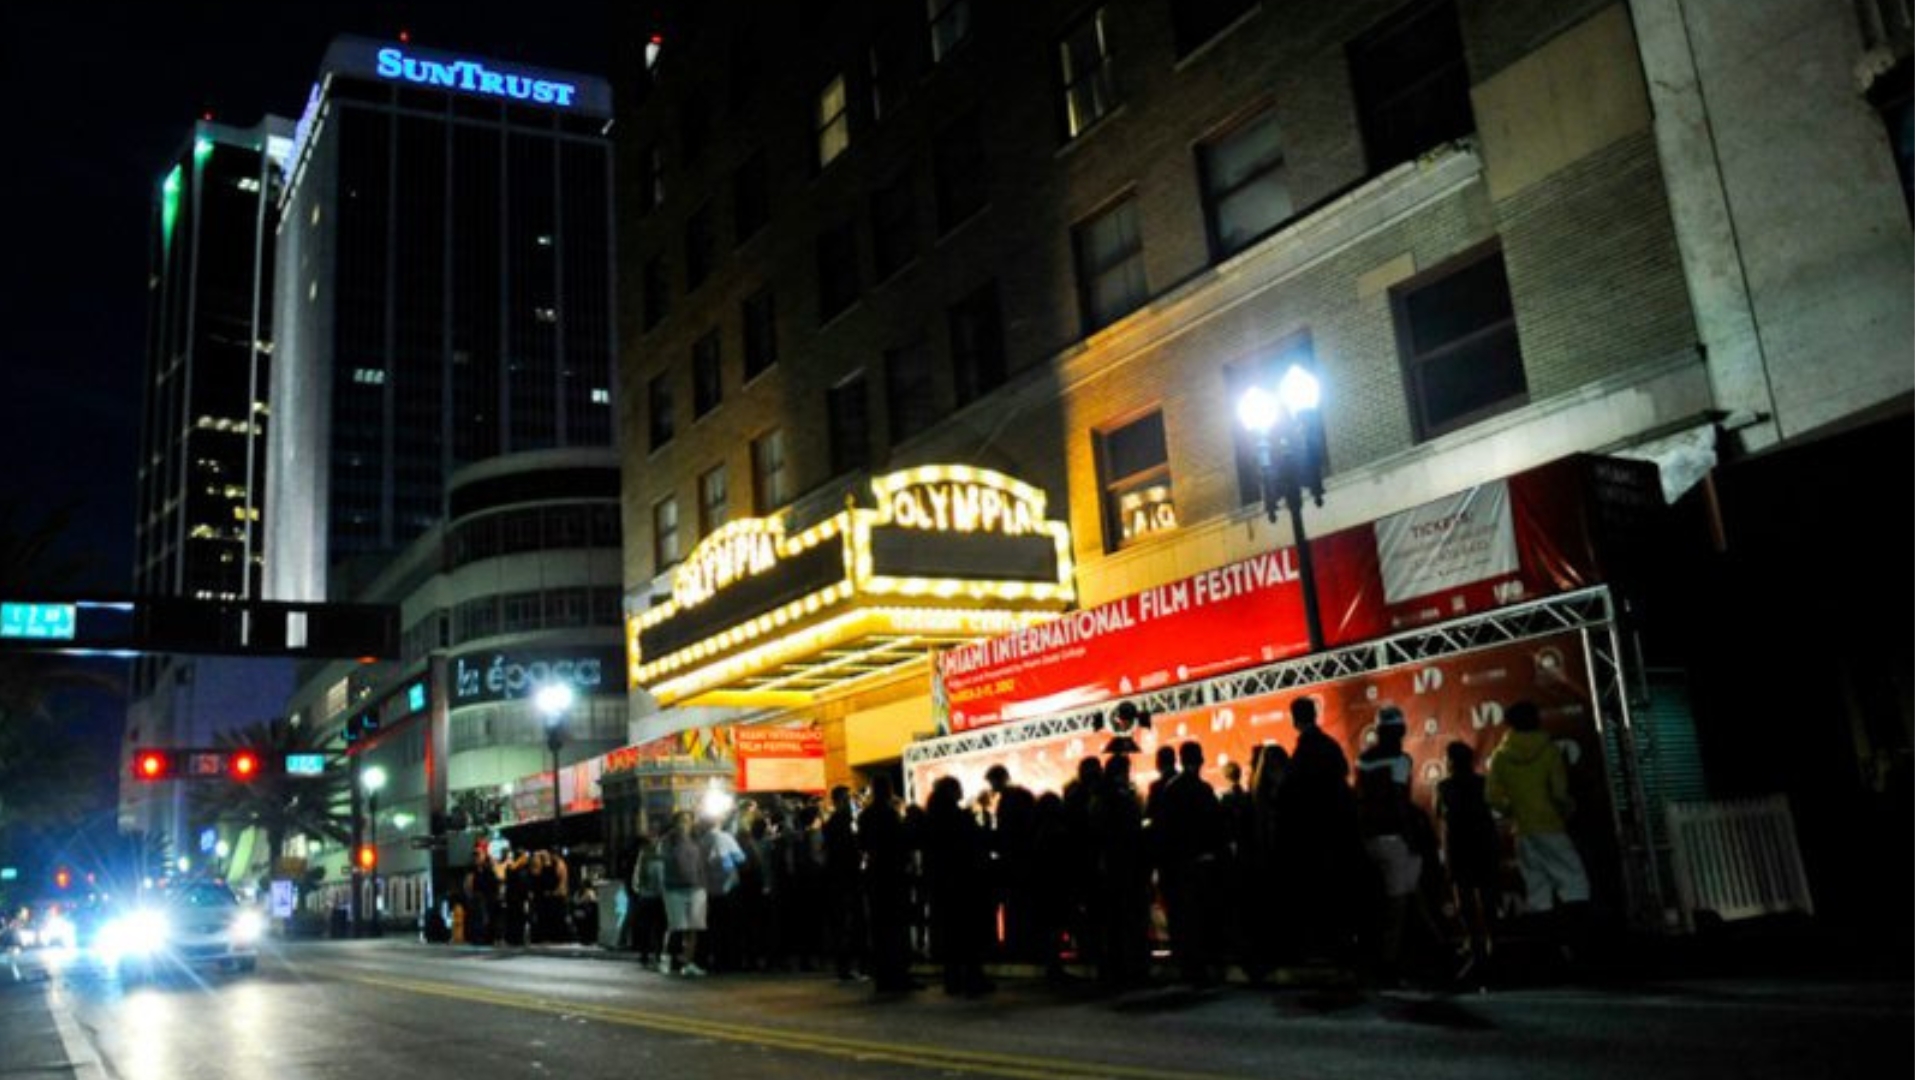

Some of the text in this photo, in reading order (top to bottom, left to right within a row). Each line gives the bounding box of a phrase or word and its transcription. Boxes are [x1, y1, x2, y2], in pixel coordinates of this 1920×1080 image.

[894, 483, 1034, 535] OLYMPIA
[945, 641, 990, 675] MIAMI
[992, 598, 1135, 664] INTERNATIONAL
[1139, 580, 1189, 622] FILM
[1194, 549, 1300, 606] FESTIVAL
[486, 655, 601, 699] época
